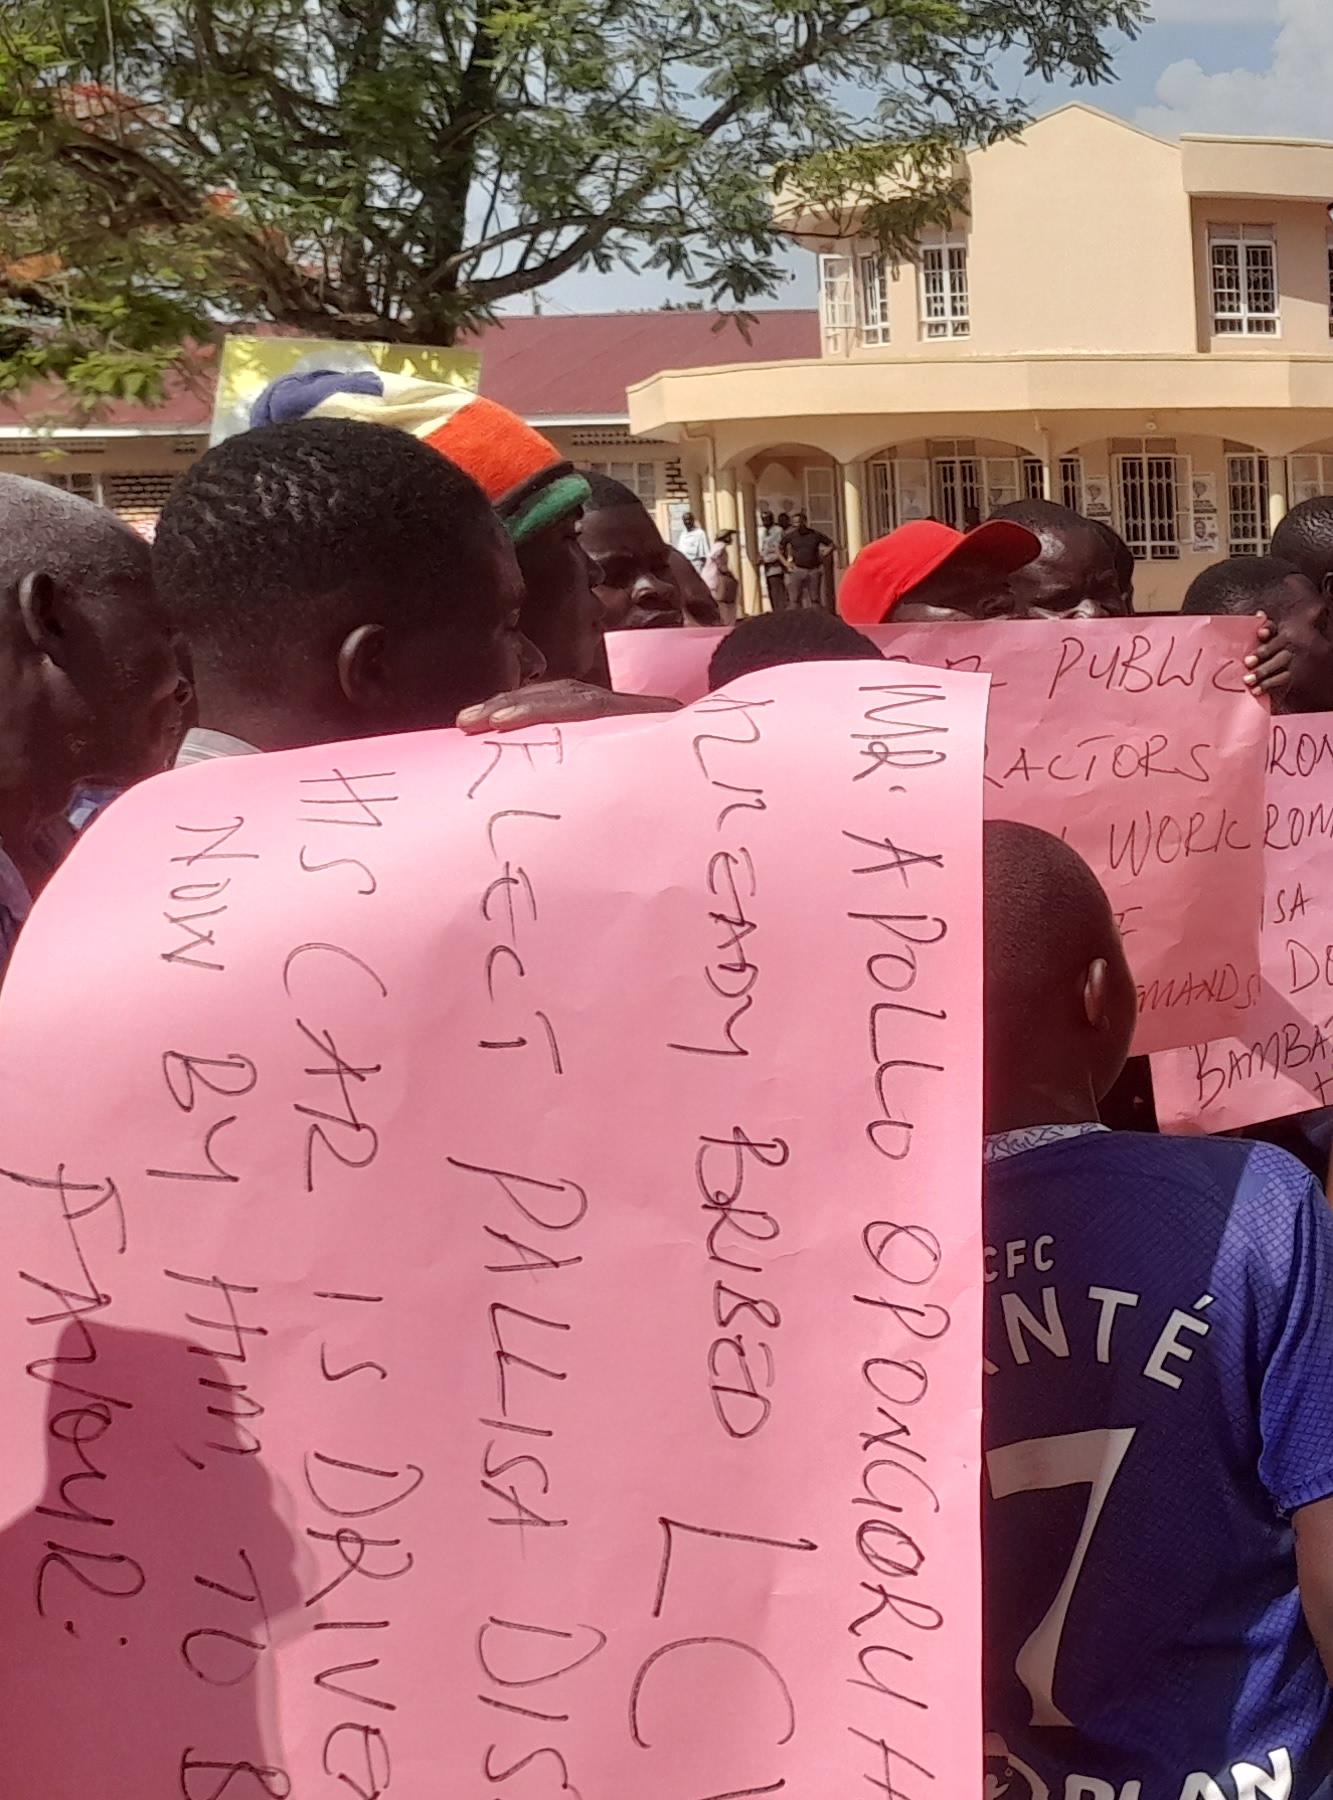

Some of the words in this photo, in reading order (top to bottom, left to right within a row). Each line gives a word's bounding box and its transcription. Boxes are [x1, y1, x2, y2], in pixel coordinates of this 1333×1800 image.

[1047, 635, 1247, 700] PUBLIC
[160, 815, 261, 971] NOW
[295, 768, 400, 896] HIS
[466, 727, 565, 1076] ELECT
[1109, 809, 1252, 877] WORK
[283, 942, 389, 1194] CAR
[841, 829, 948, 1161] APOLLO
[446, 1156, 590, 1559] PALLISA
[693, 1127, 792, 1441] BRIBED
[984, 1285, 1215, 1391] NTÉ
[182, 1547, 272, 1687] TO
[985, 1426, 1137, 1728] 7
